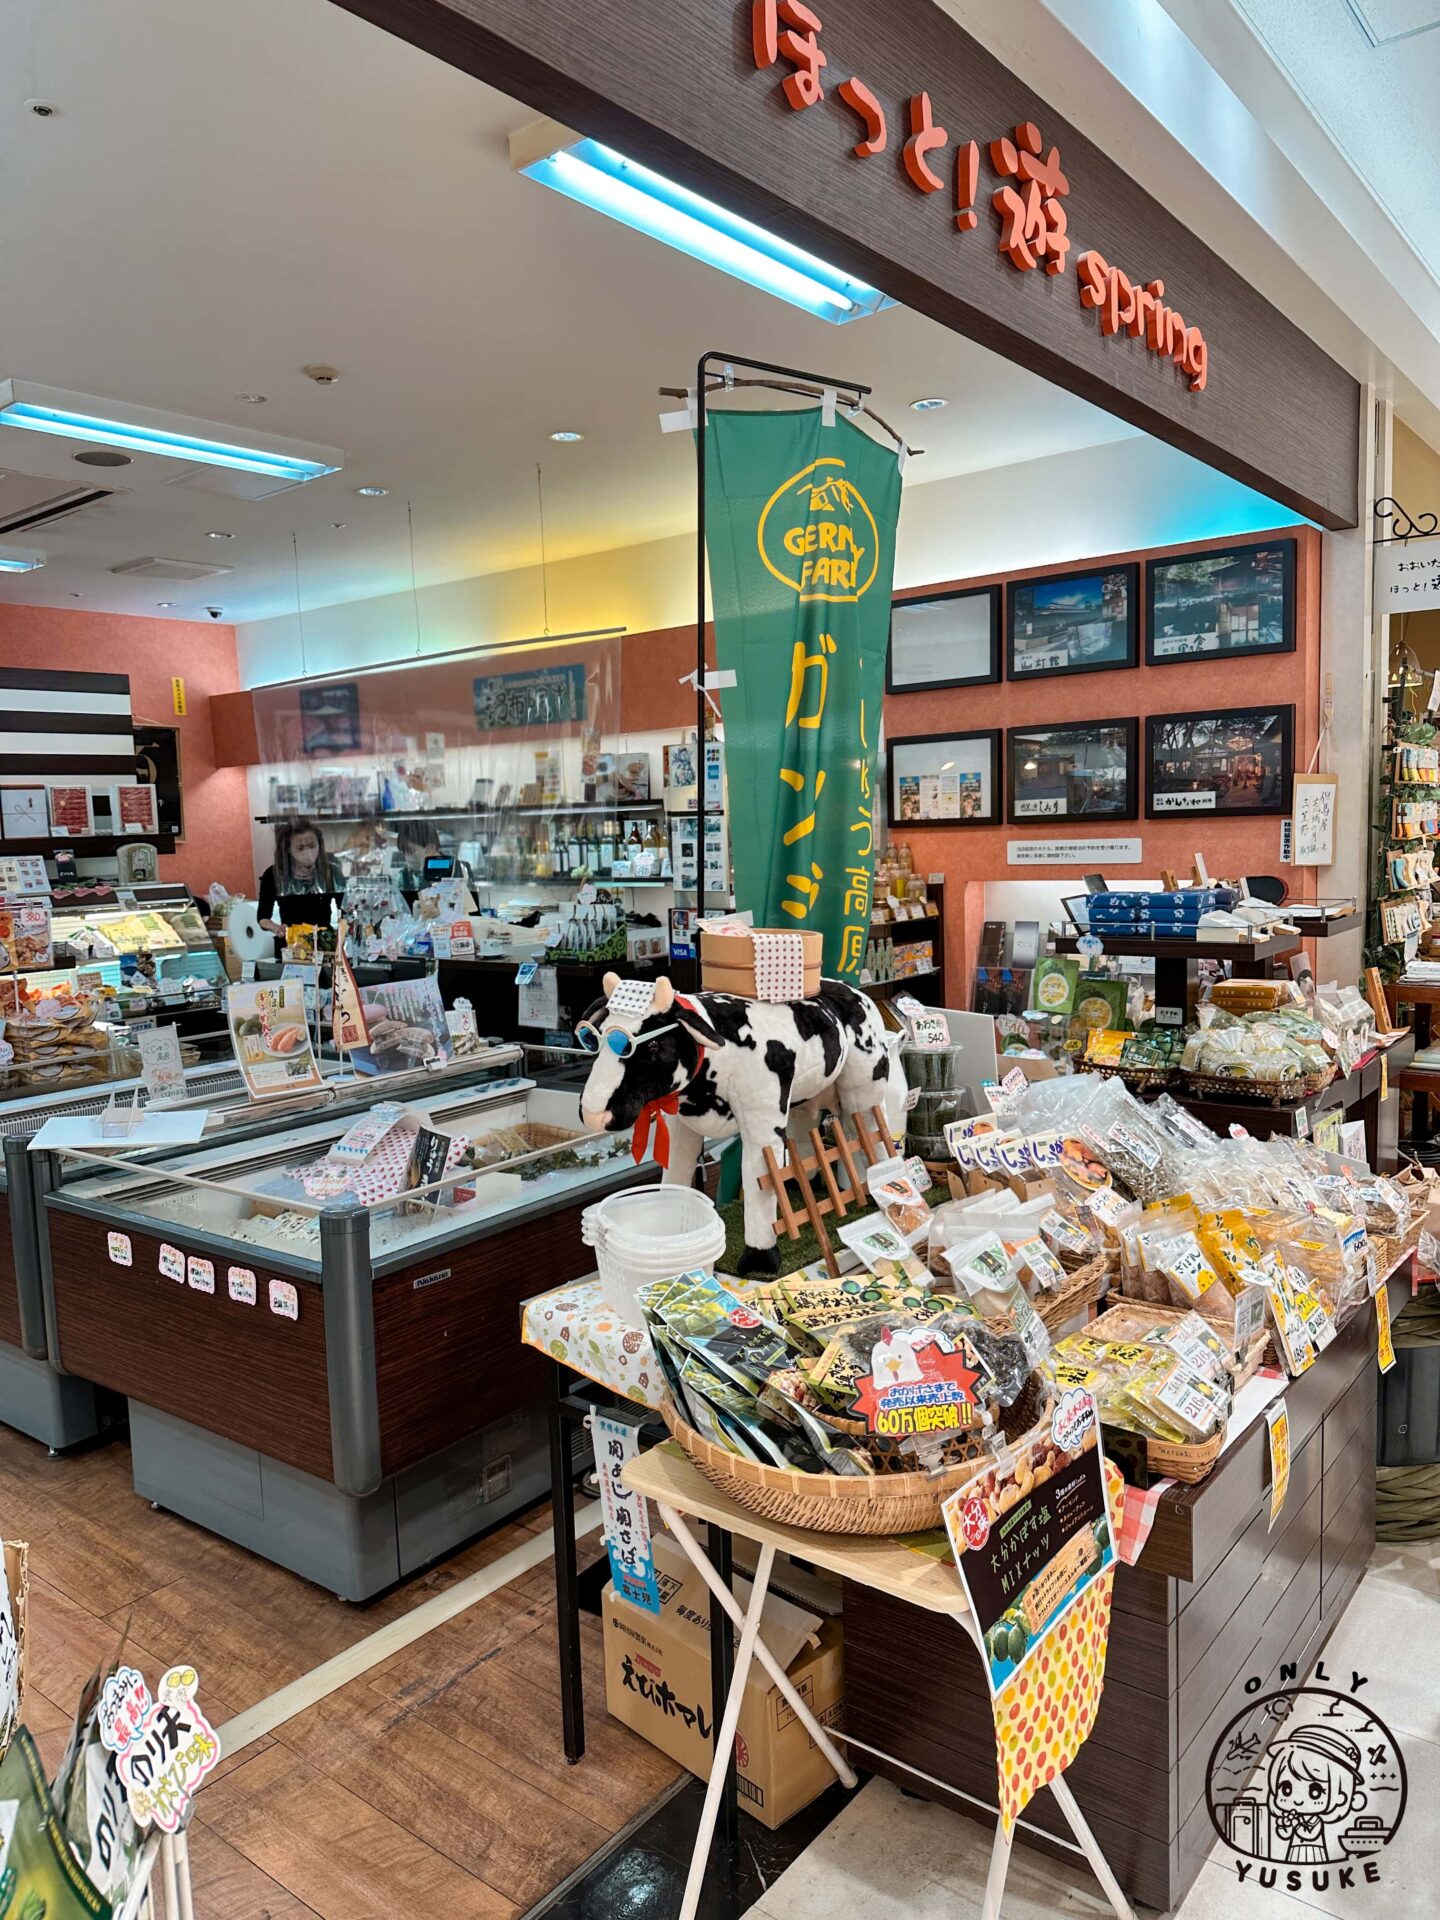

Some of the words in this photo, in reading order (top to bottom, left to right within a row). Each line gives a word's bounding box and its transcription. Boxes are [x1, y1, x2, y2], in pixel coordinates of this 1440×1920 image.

[1077, 249, 1208, 391] spring
[673, 948, 688, 956] VISA
[927, 1032, 944, 1044] 540
[880, 1391, 965, 1409] 発売以来売上数
[889, 1382, 957, 1398] おかげさまで
[877, 1402, 973, 1435] 60万個突破!!
[991, 1504, 1052, 1574] 大分かぼす塩
[1001, 1533, 1050, 1595] MIXナッツ
